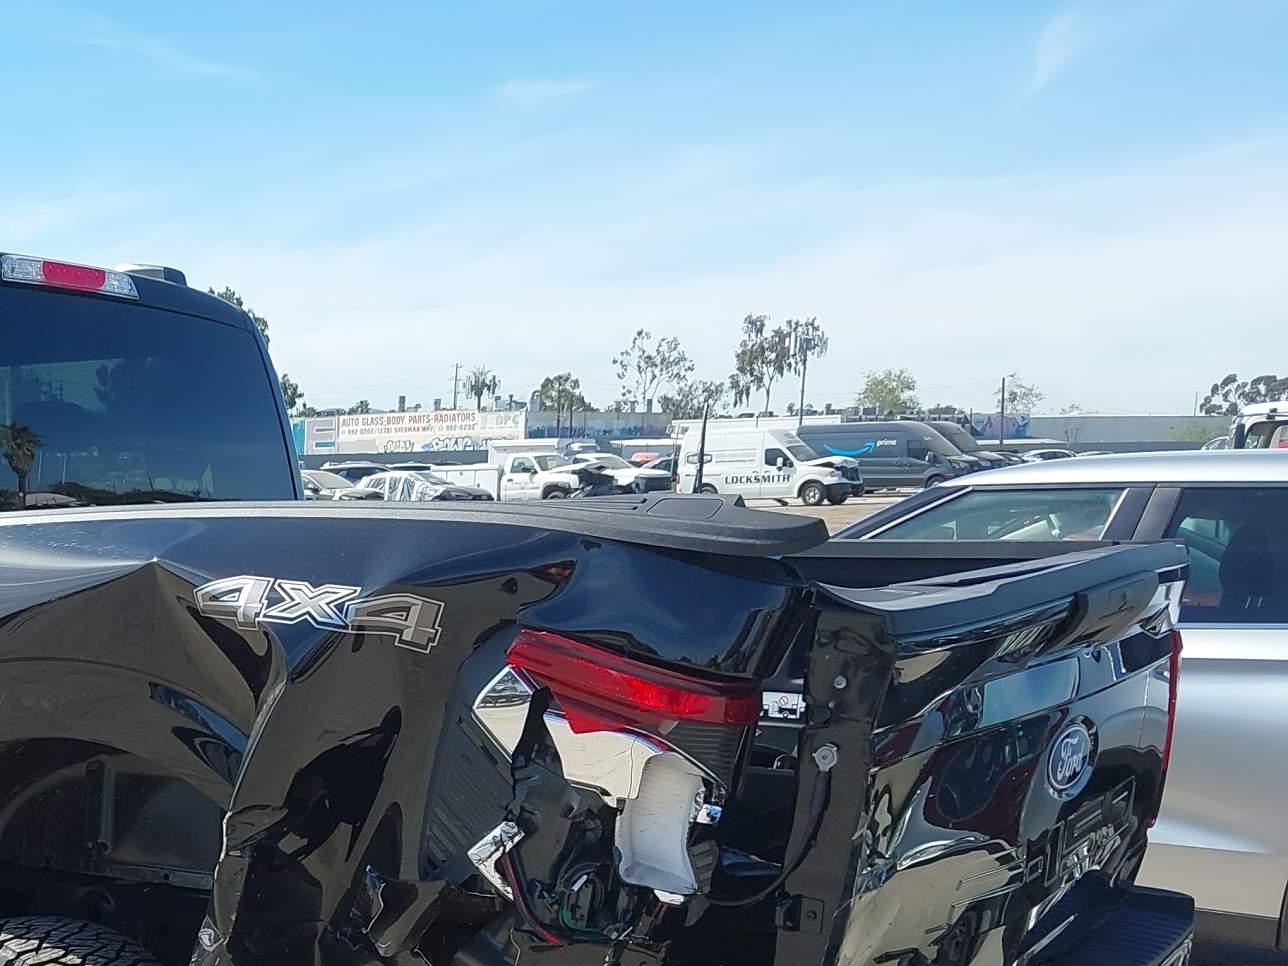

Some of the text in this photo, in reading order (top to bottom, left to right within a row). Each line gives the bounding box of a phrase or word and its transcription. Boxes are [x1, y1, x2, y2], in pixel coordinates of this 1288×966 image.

[341, 418, 360, 427] AUTO
[876, 438, 897, 448] prime
[724, 474, 791, 485] LOCKSMITH
[1056, 735, 1086, 782] Ford
